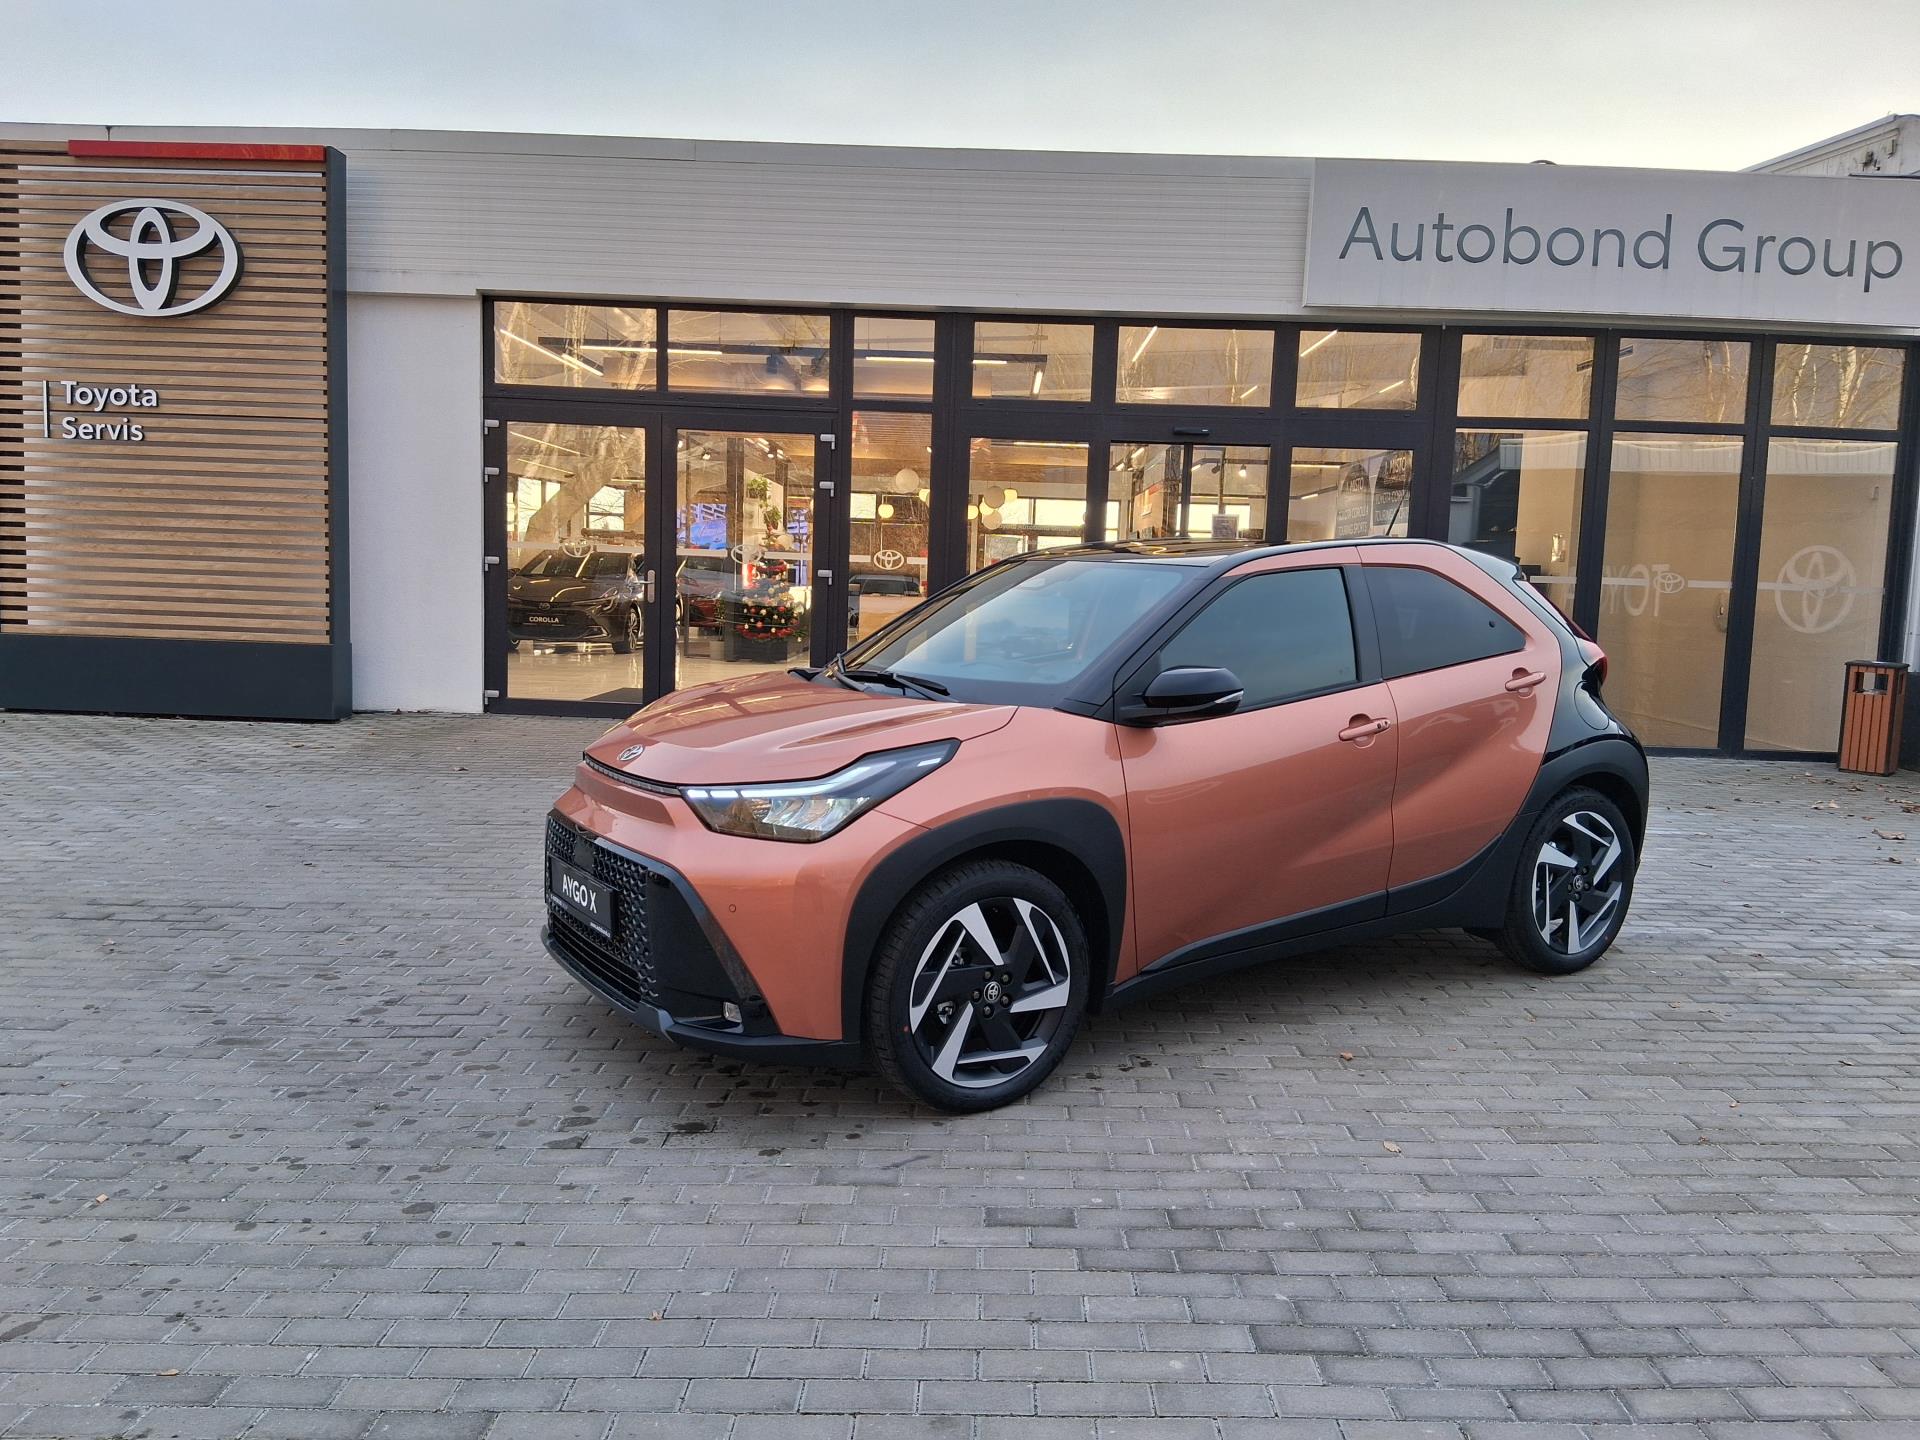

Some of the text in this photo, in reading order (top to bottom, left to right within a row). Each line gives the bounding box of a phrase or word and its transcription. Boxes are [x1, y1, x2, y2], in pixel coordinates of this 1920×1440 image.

[1338, 206, 1904, 293] Autobond Group
[60, 380, 158, 412] Toyota
[62, 416, 144, 441] Servis
[562, 873, 588, 907] AYGO
[589, 889, 597, 914] X
